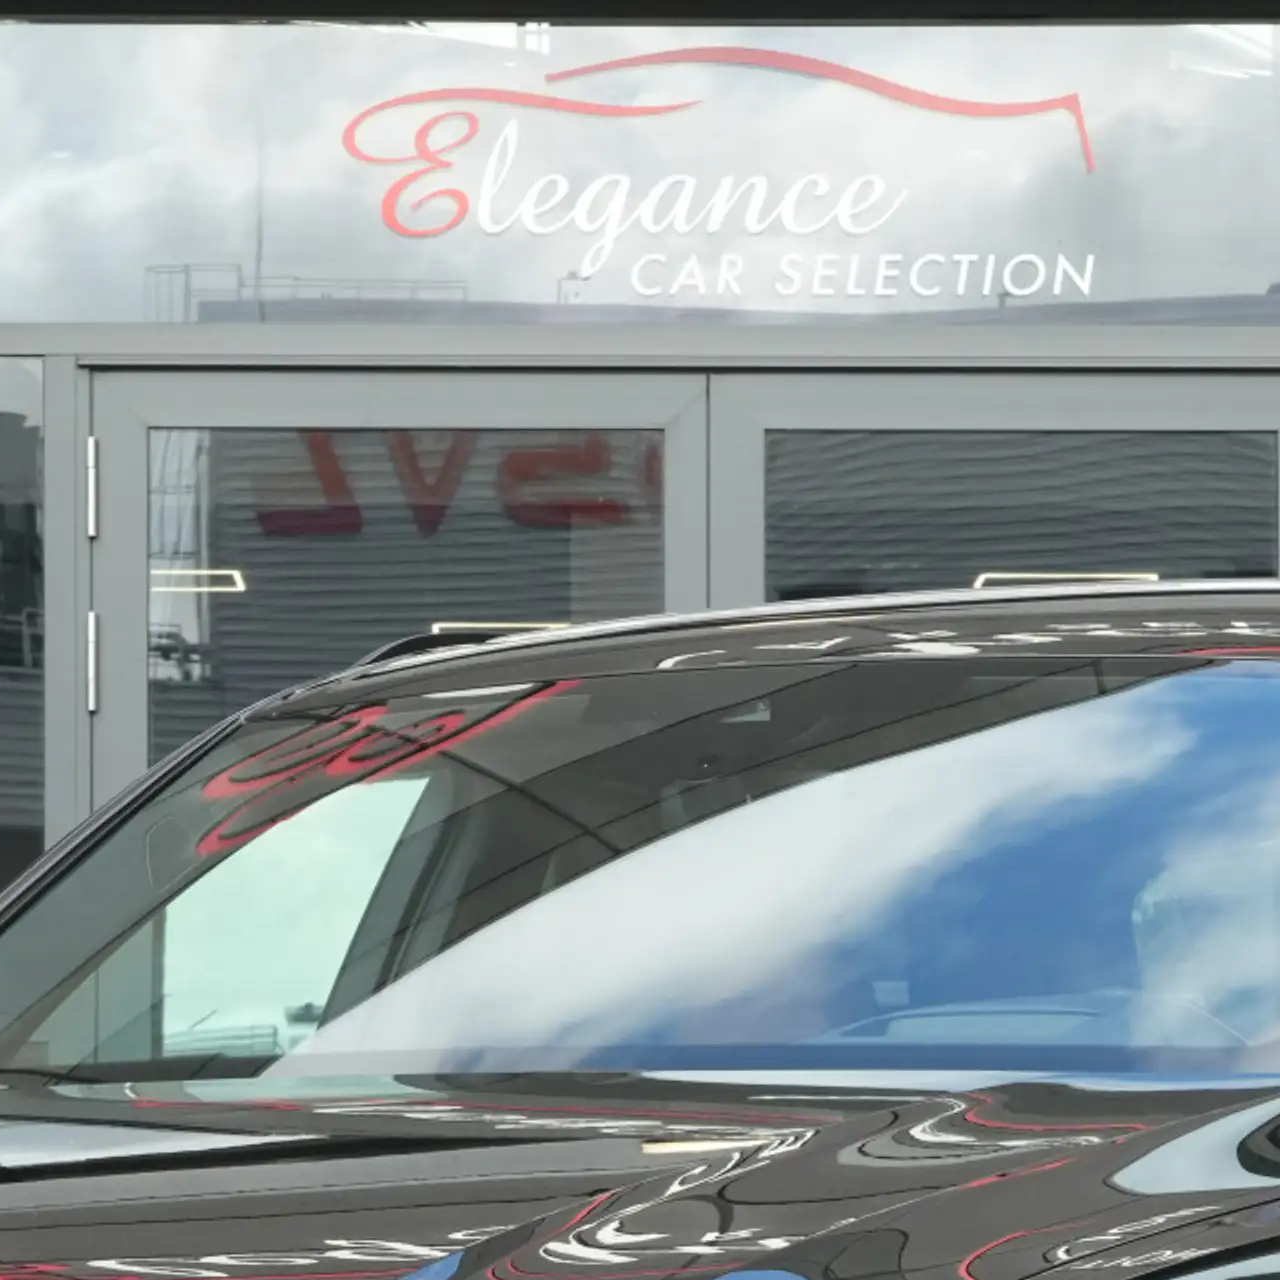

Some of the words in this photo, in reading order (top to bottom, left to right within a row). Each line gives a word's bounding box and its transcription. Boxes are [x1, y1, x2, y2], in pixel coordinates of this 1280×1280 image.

[342, 88, 909, 281] Elegance
[631, 253, 744, 297] CAR
[774, 253, 1095, 298] SELECTION
